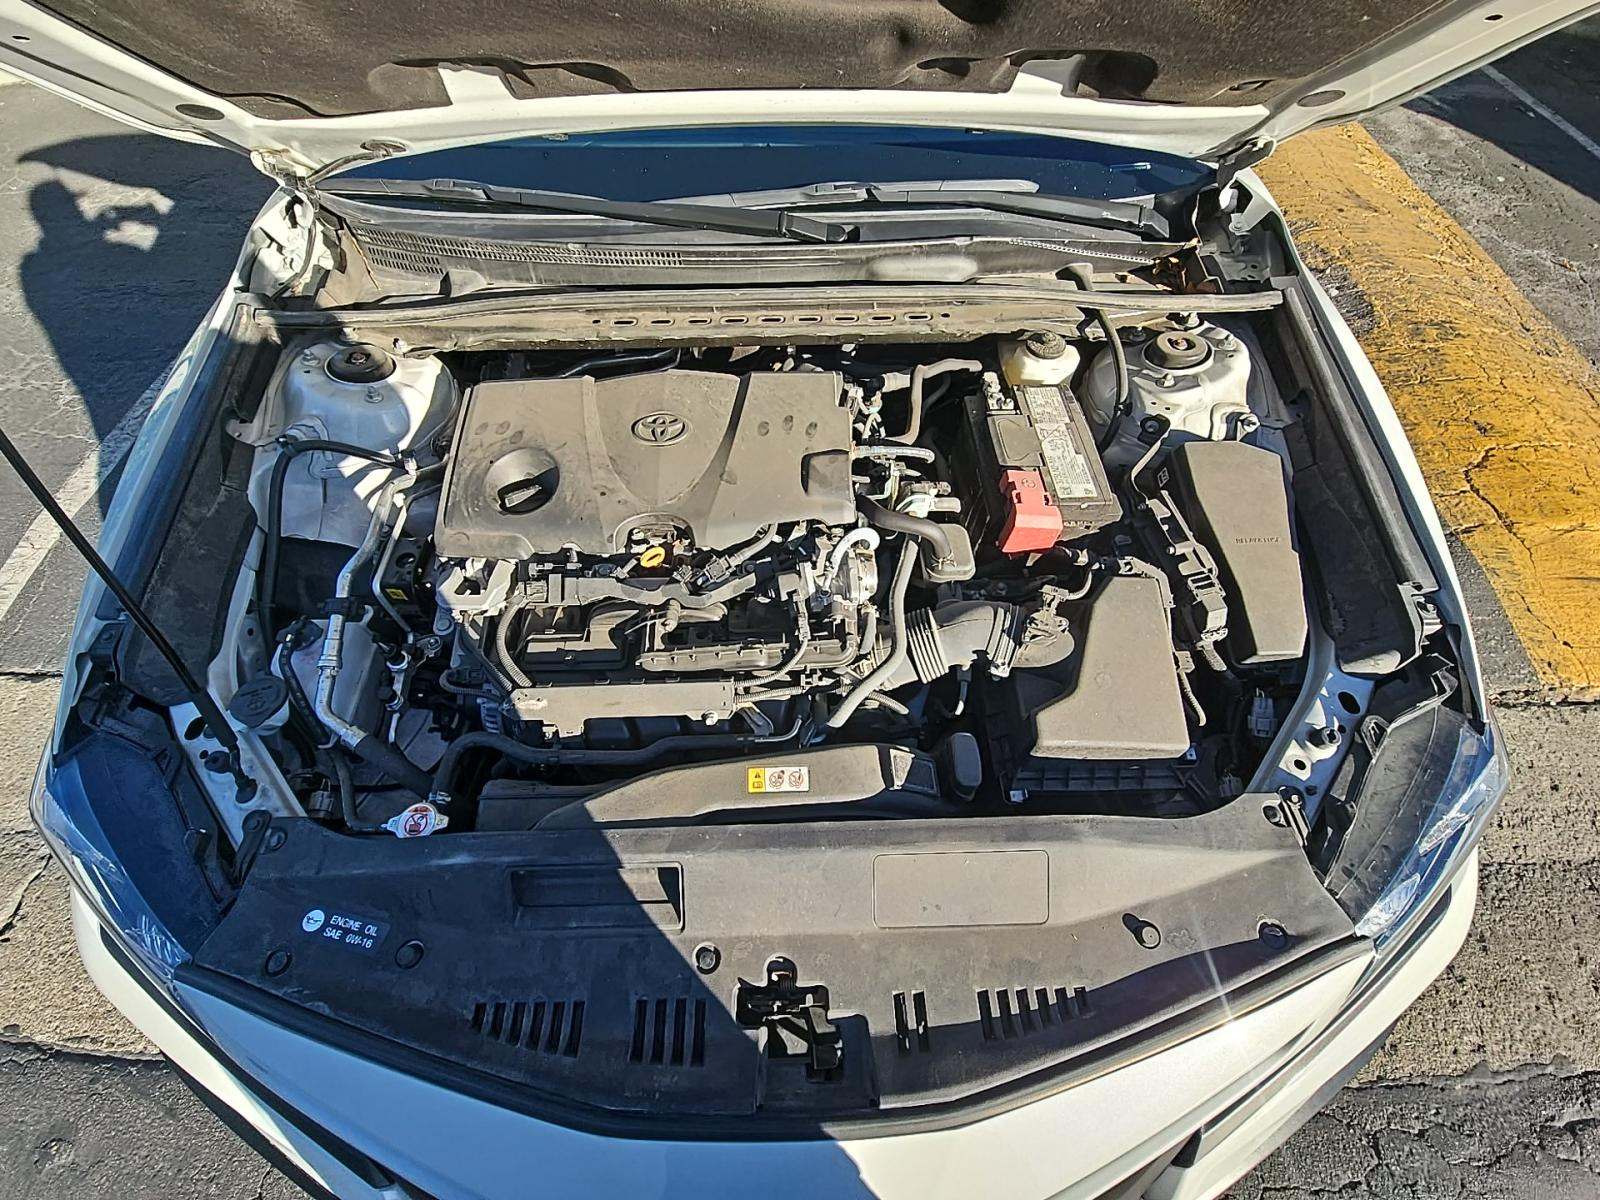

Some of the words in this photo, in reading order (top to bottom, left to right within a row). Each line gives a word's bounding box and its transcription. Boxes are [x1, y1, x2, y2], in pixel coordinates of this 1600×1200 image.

[330, 915, 362, 931] ENGINE
[364, 925, 377, 936] OIL
[324, 927, 343, 940] SAE
[345, 934, 373, 948] 0W-16
